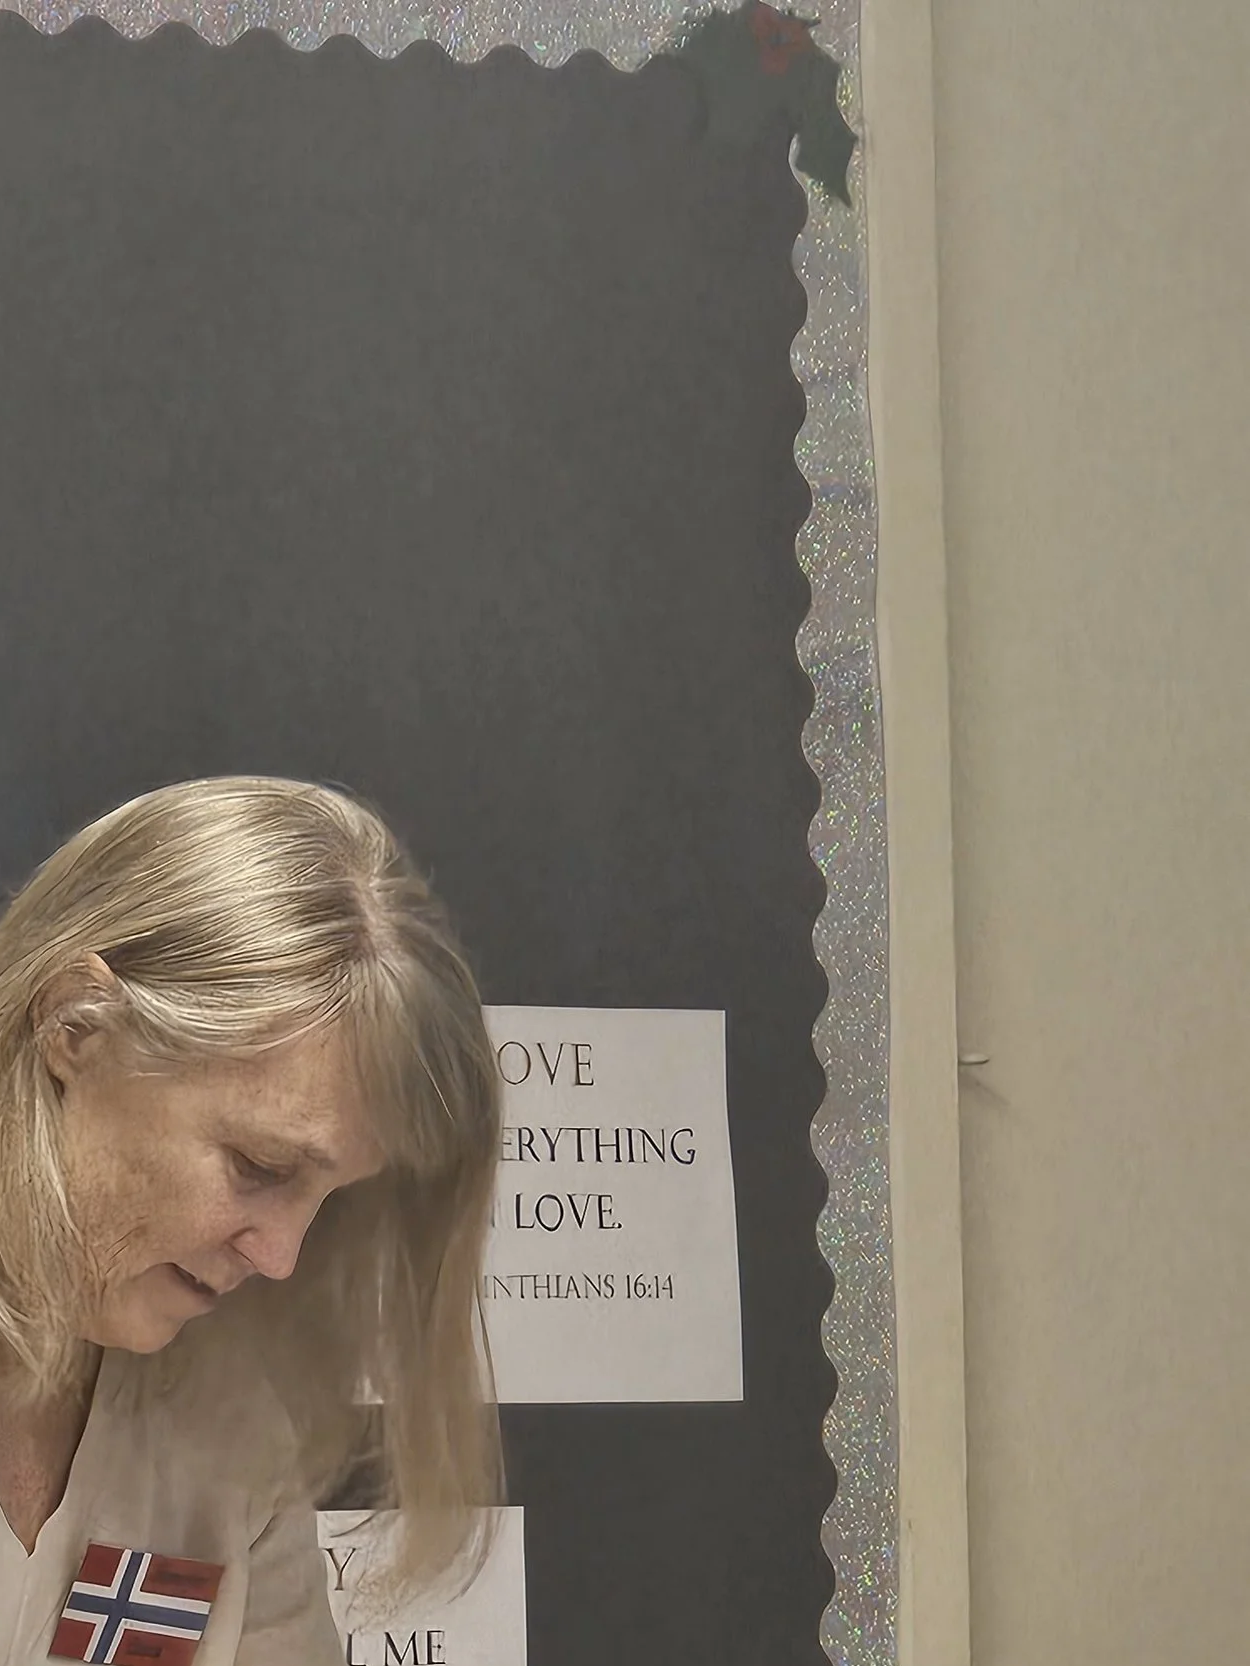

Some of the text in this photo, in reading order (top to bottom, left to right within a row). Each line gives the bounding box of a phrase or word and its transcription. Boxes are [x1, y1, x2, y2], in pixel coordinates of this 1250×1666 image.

[498, 1040, 594, 1087] OVE
[501, 1126, 697, 1165] ERYTHING
[514, 1192, 623, 1233] LOVE.
[484, 1272, 676, 1301] INTHIANS 16:14
